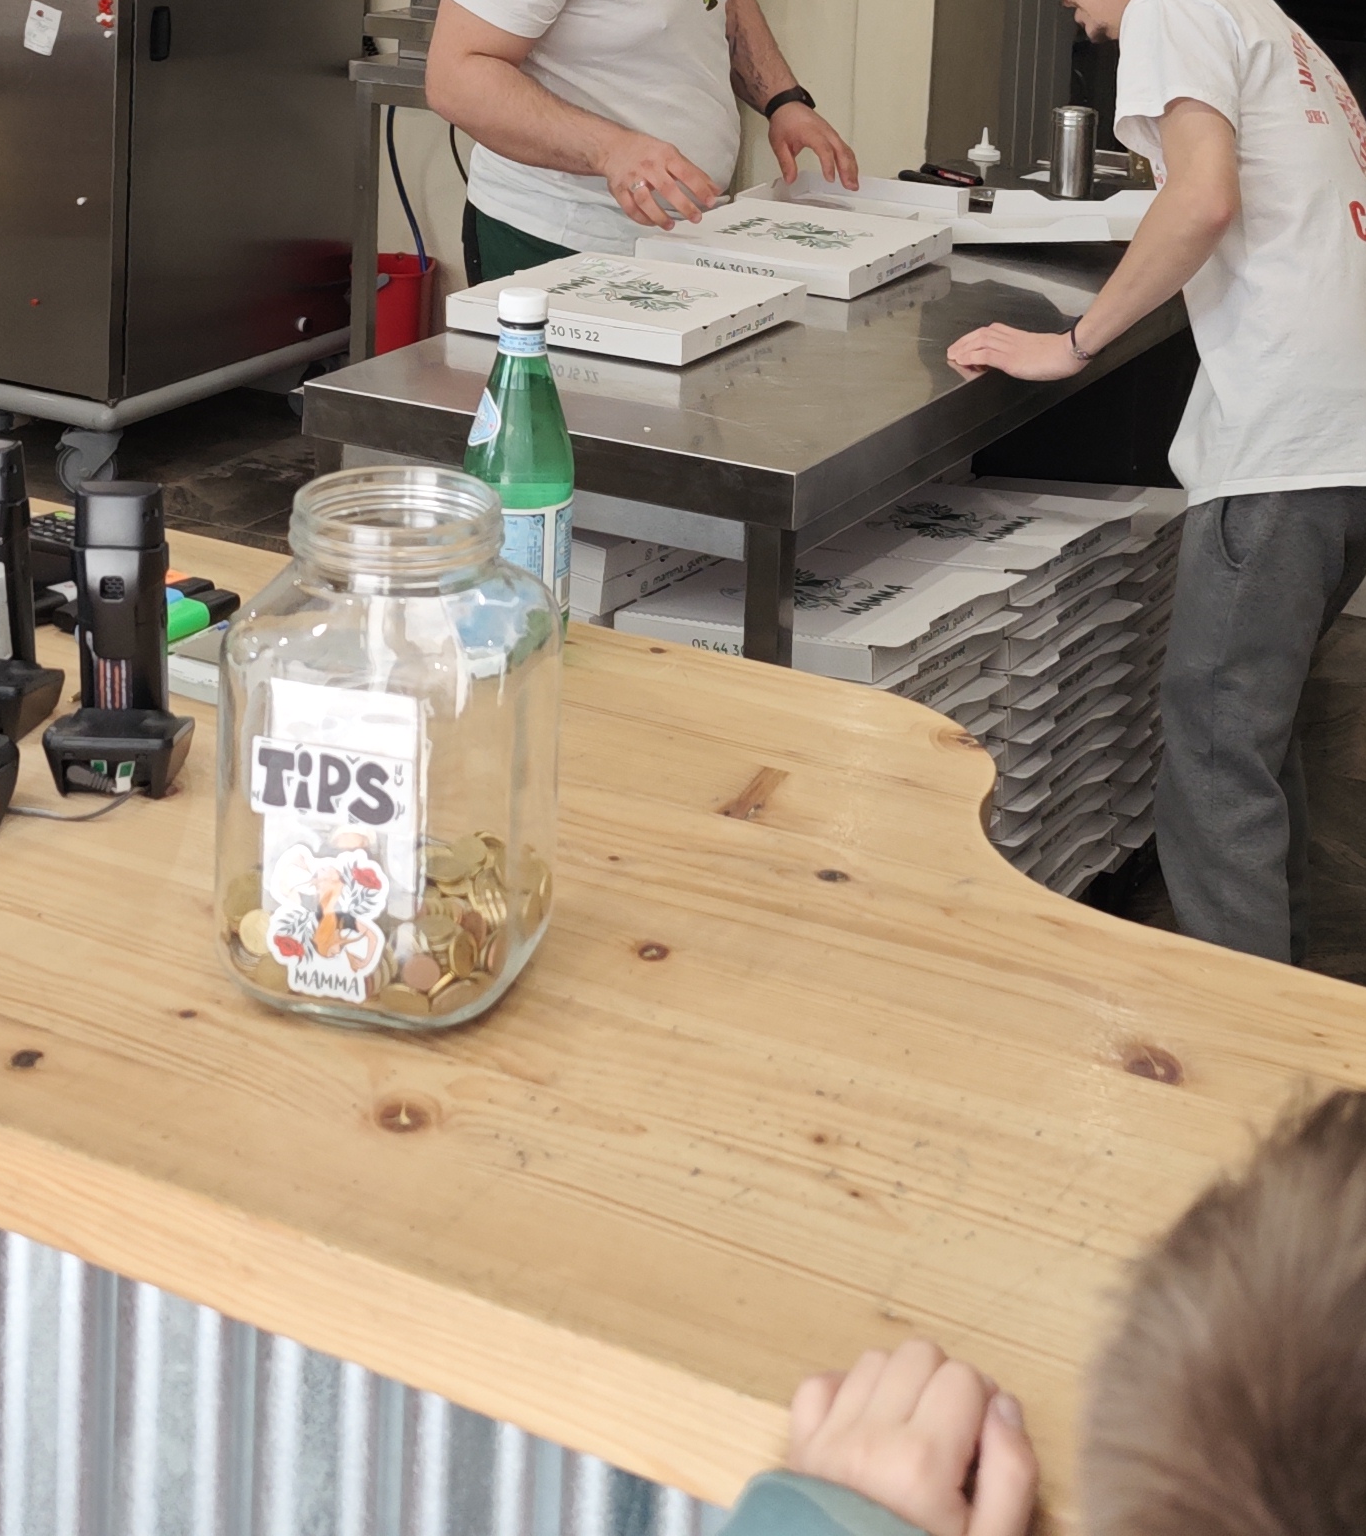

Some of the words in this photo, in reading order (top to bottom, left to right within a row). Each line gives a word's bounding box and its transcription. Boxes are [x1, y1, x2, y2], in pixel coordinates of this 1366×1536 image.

[550, 324, 565, 337] 30
[569, 327, 582, 340] 15
[585, 330, 600, 343] 22
[725, 311, 775, 341] mamma_gueret
[712, 643, 728, 655] 44
[294, 968, 360, 996] MAMMA
